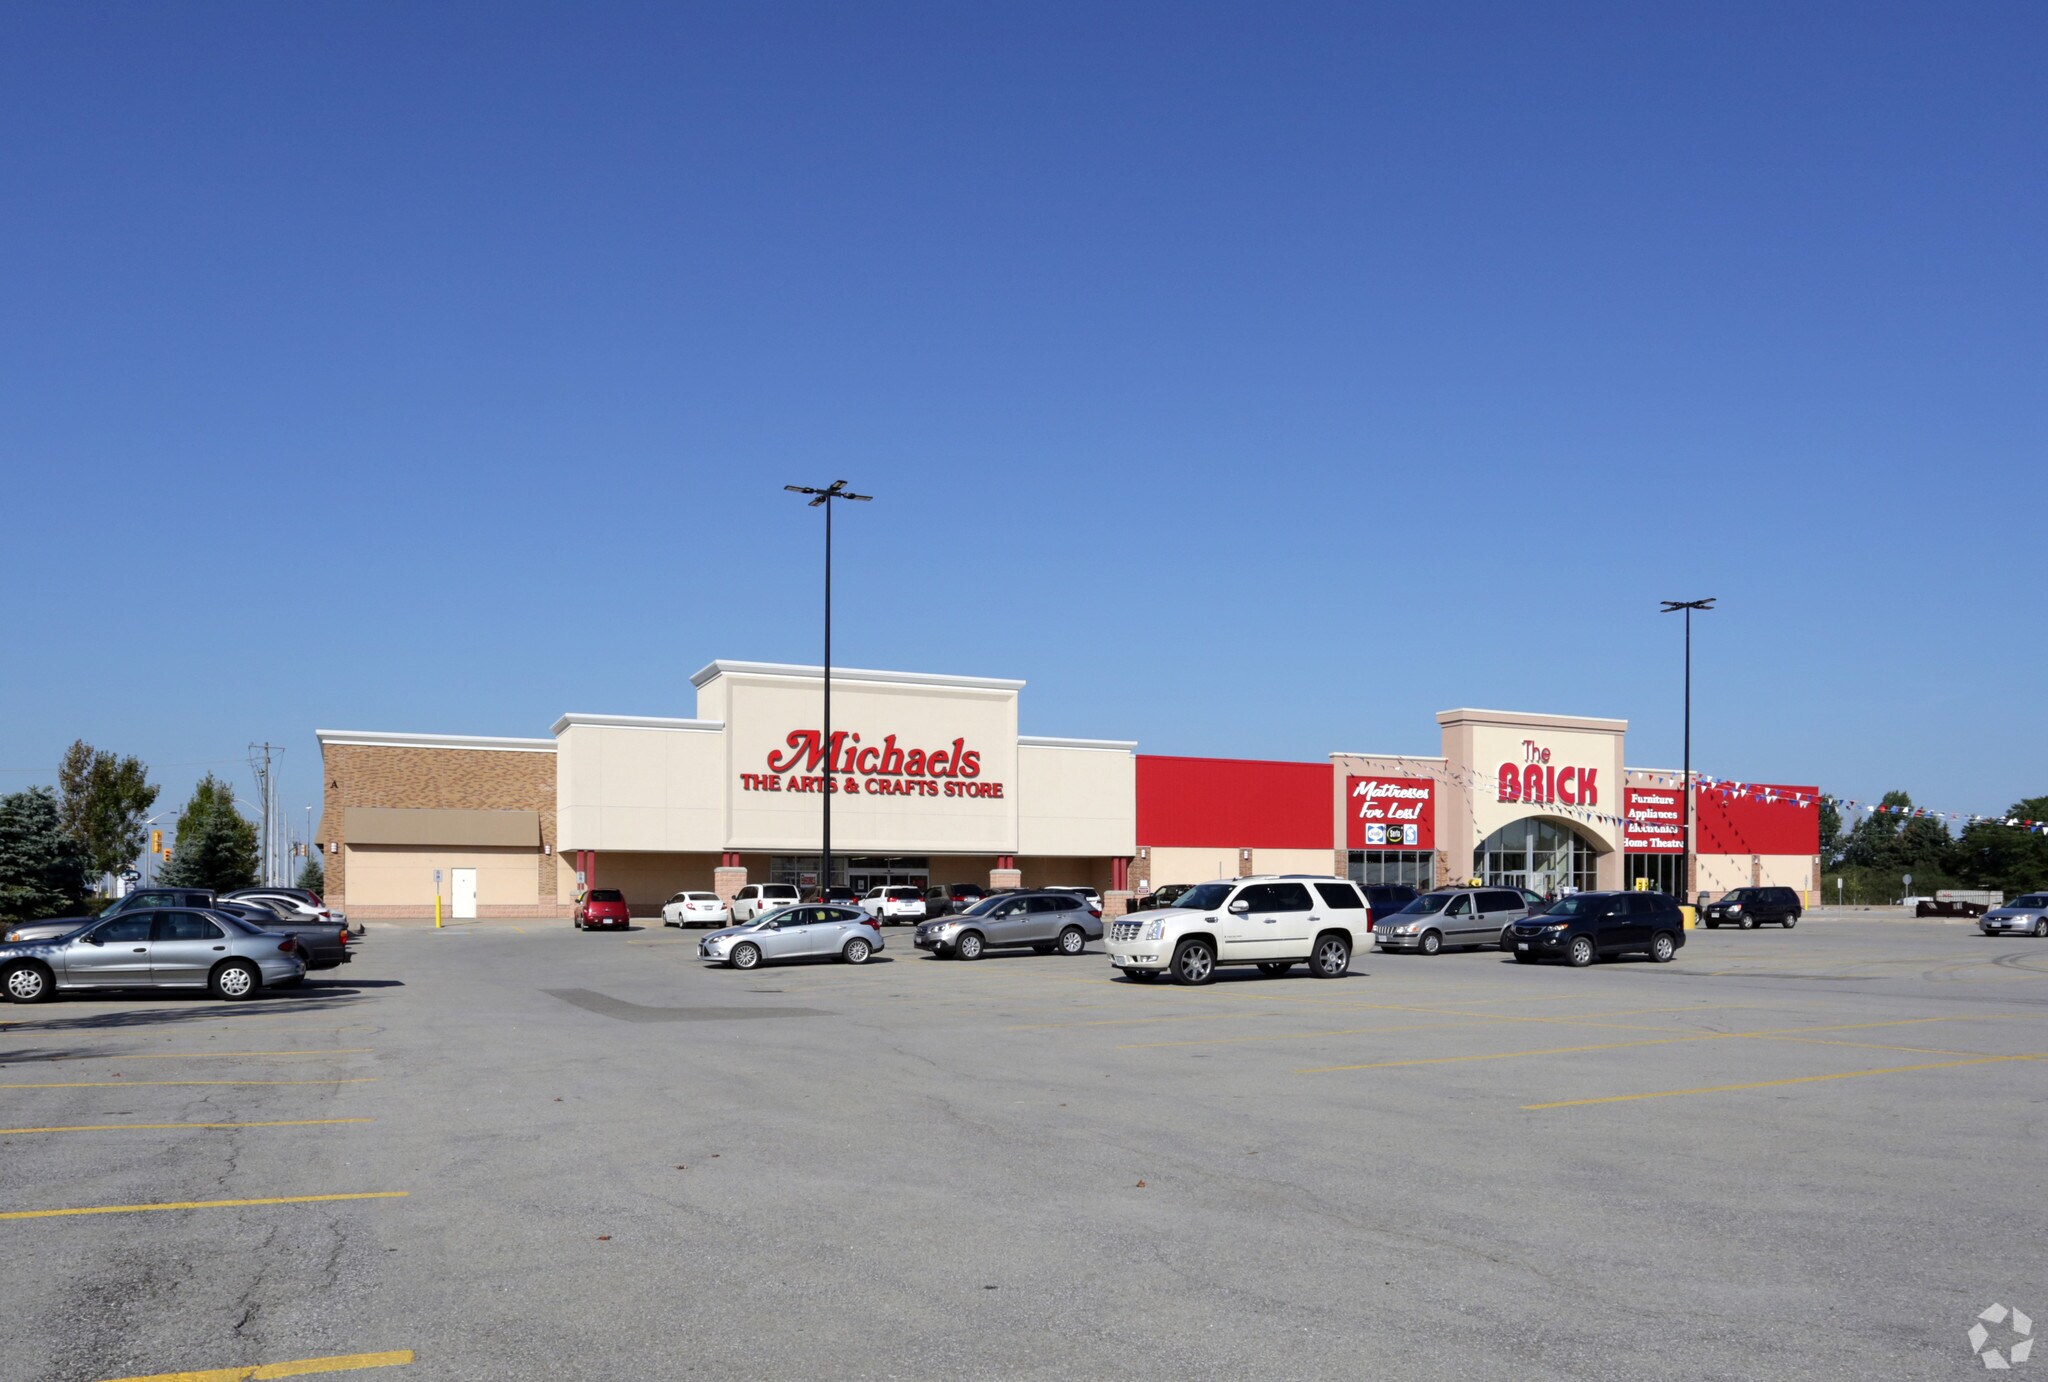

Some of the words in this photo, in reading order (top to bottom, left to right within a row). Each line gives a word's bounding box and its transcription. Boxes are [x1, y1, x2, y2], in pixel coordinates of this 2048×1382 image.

[767, 729, 981, 778] Michaels
[1521, 740, 1551, 764] The
[740, 773, 781, 791] THE
[787, 775, 838, 793] ARTS
[844, 777, 860, 794] &
[865, 777, 939, 796] CRAFTS
[944, 780, 1004, 798] STORE
[1353, 781, 1429, 801] Mattresses
[1498, 762, 1598, 806] BRICK
[1631, 793, 1675, 804] Furniture
[1360, 801, 1385, 818] For
[1387, 802, 1423, 819] Less!
[1628, 808, 1678, 820] Appliances
